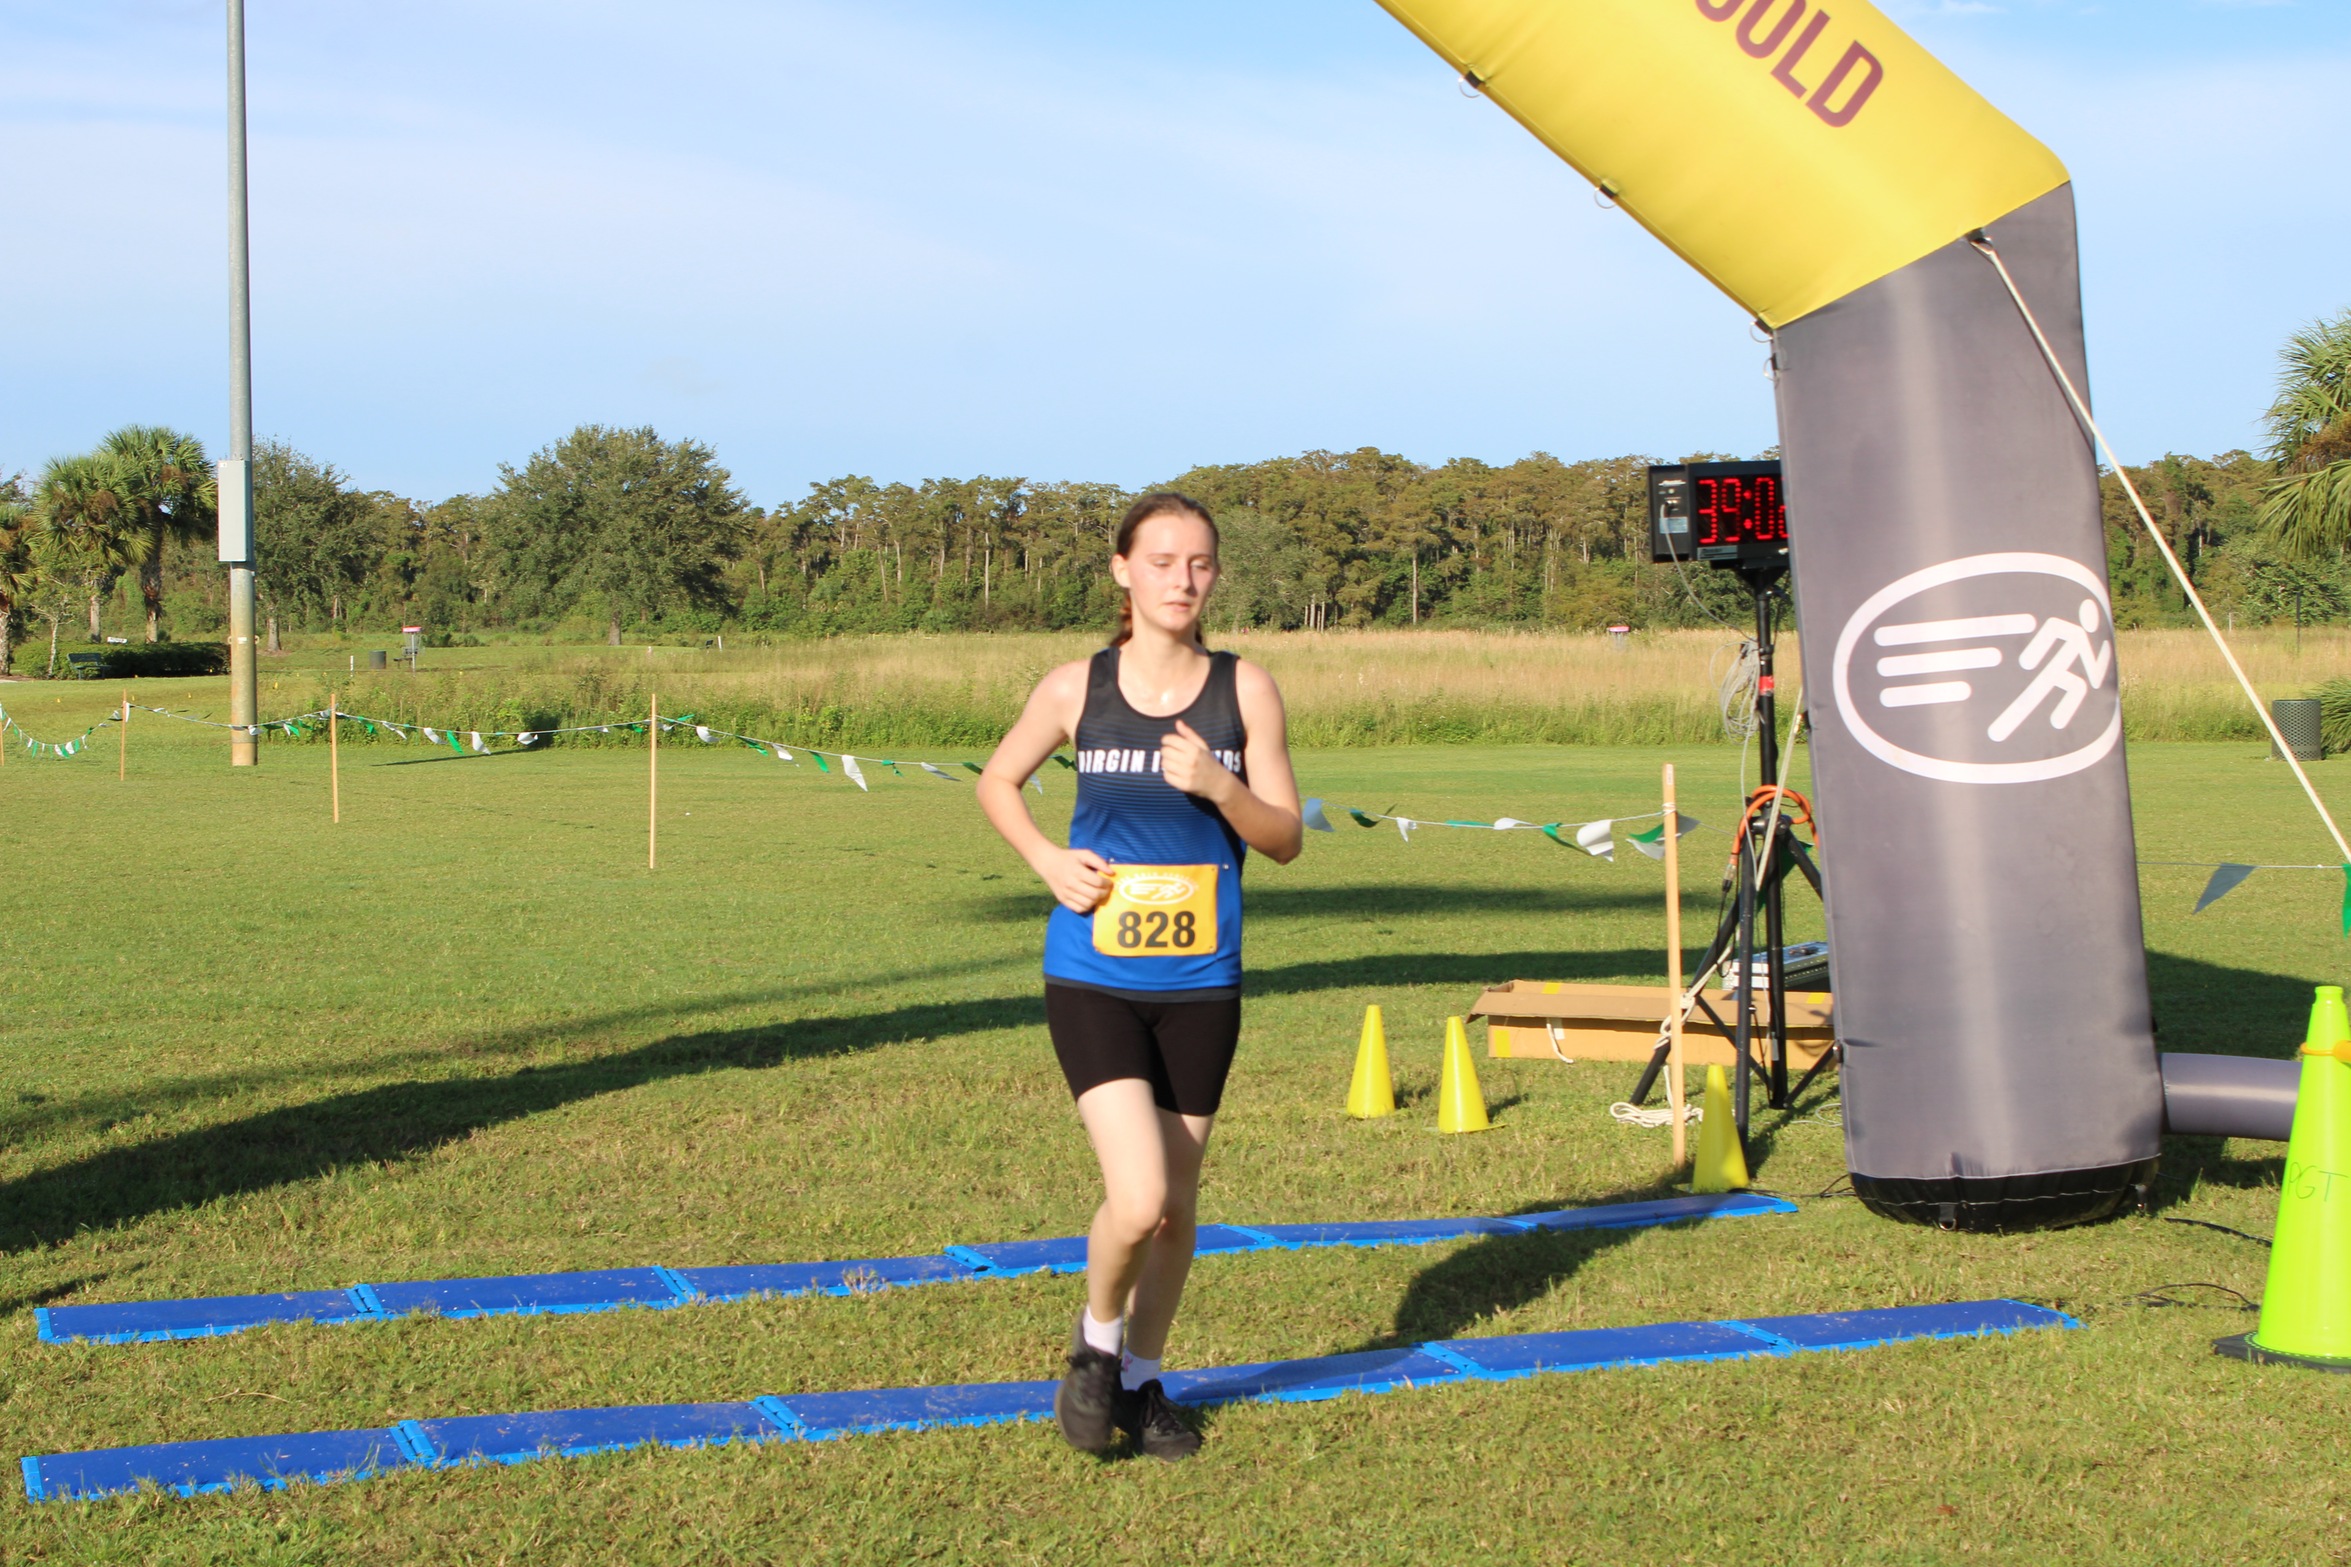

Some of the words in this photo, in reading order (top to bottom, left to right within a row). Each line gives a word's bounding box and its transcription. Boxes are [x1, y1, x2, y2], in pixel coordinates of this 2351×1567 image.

[1695, 0, 1884, 128] OLD
[1078, 749, 1146, 773] VIRGIN
[1117, 910, 1196, 949] 828
[2287, 1161, 2349, 1202] PGT
